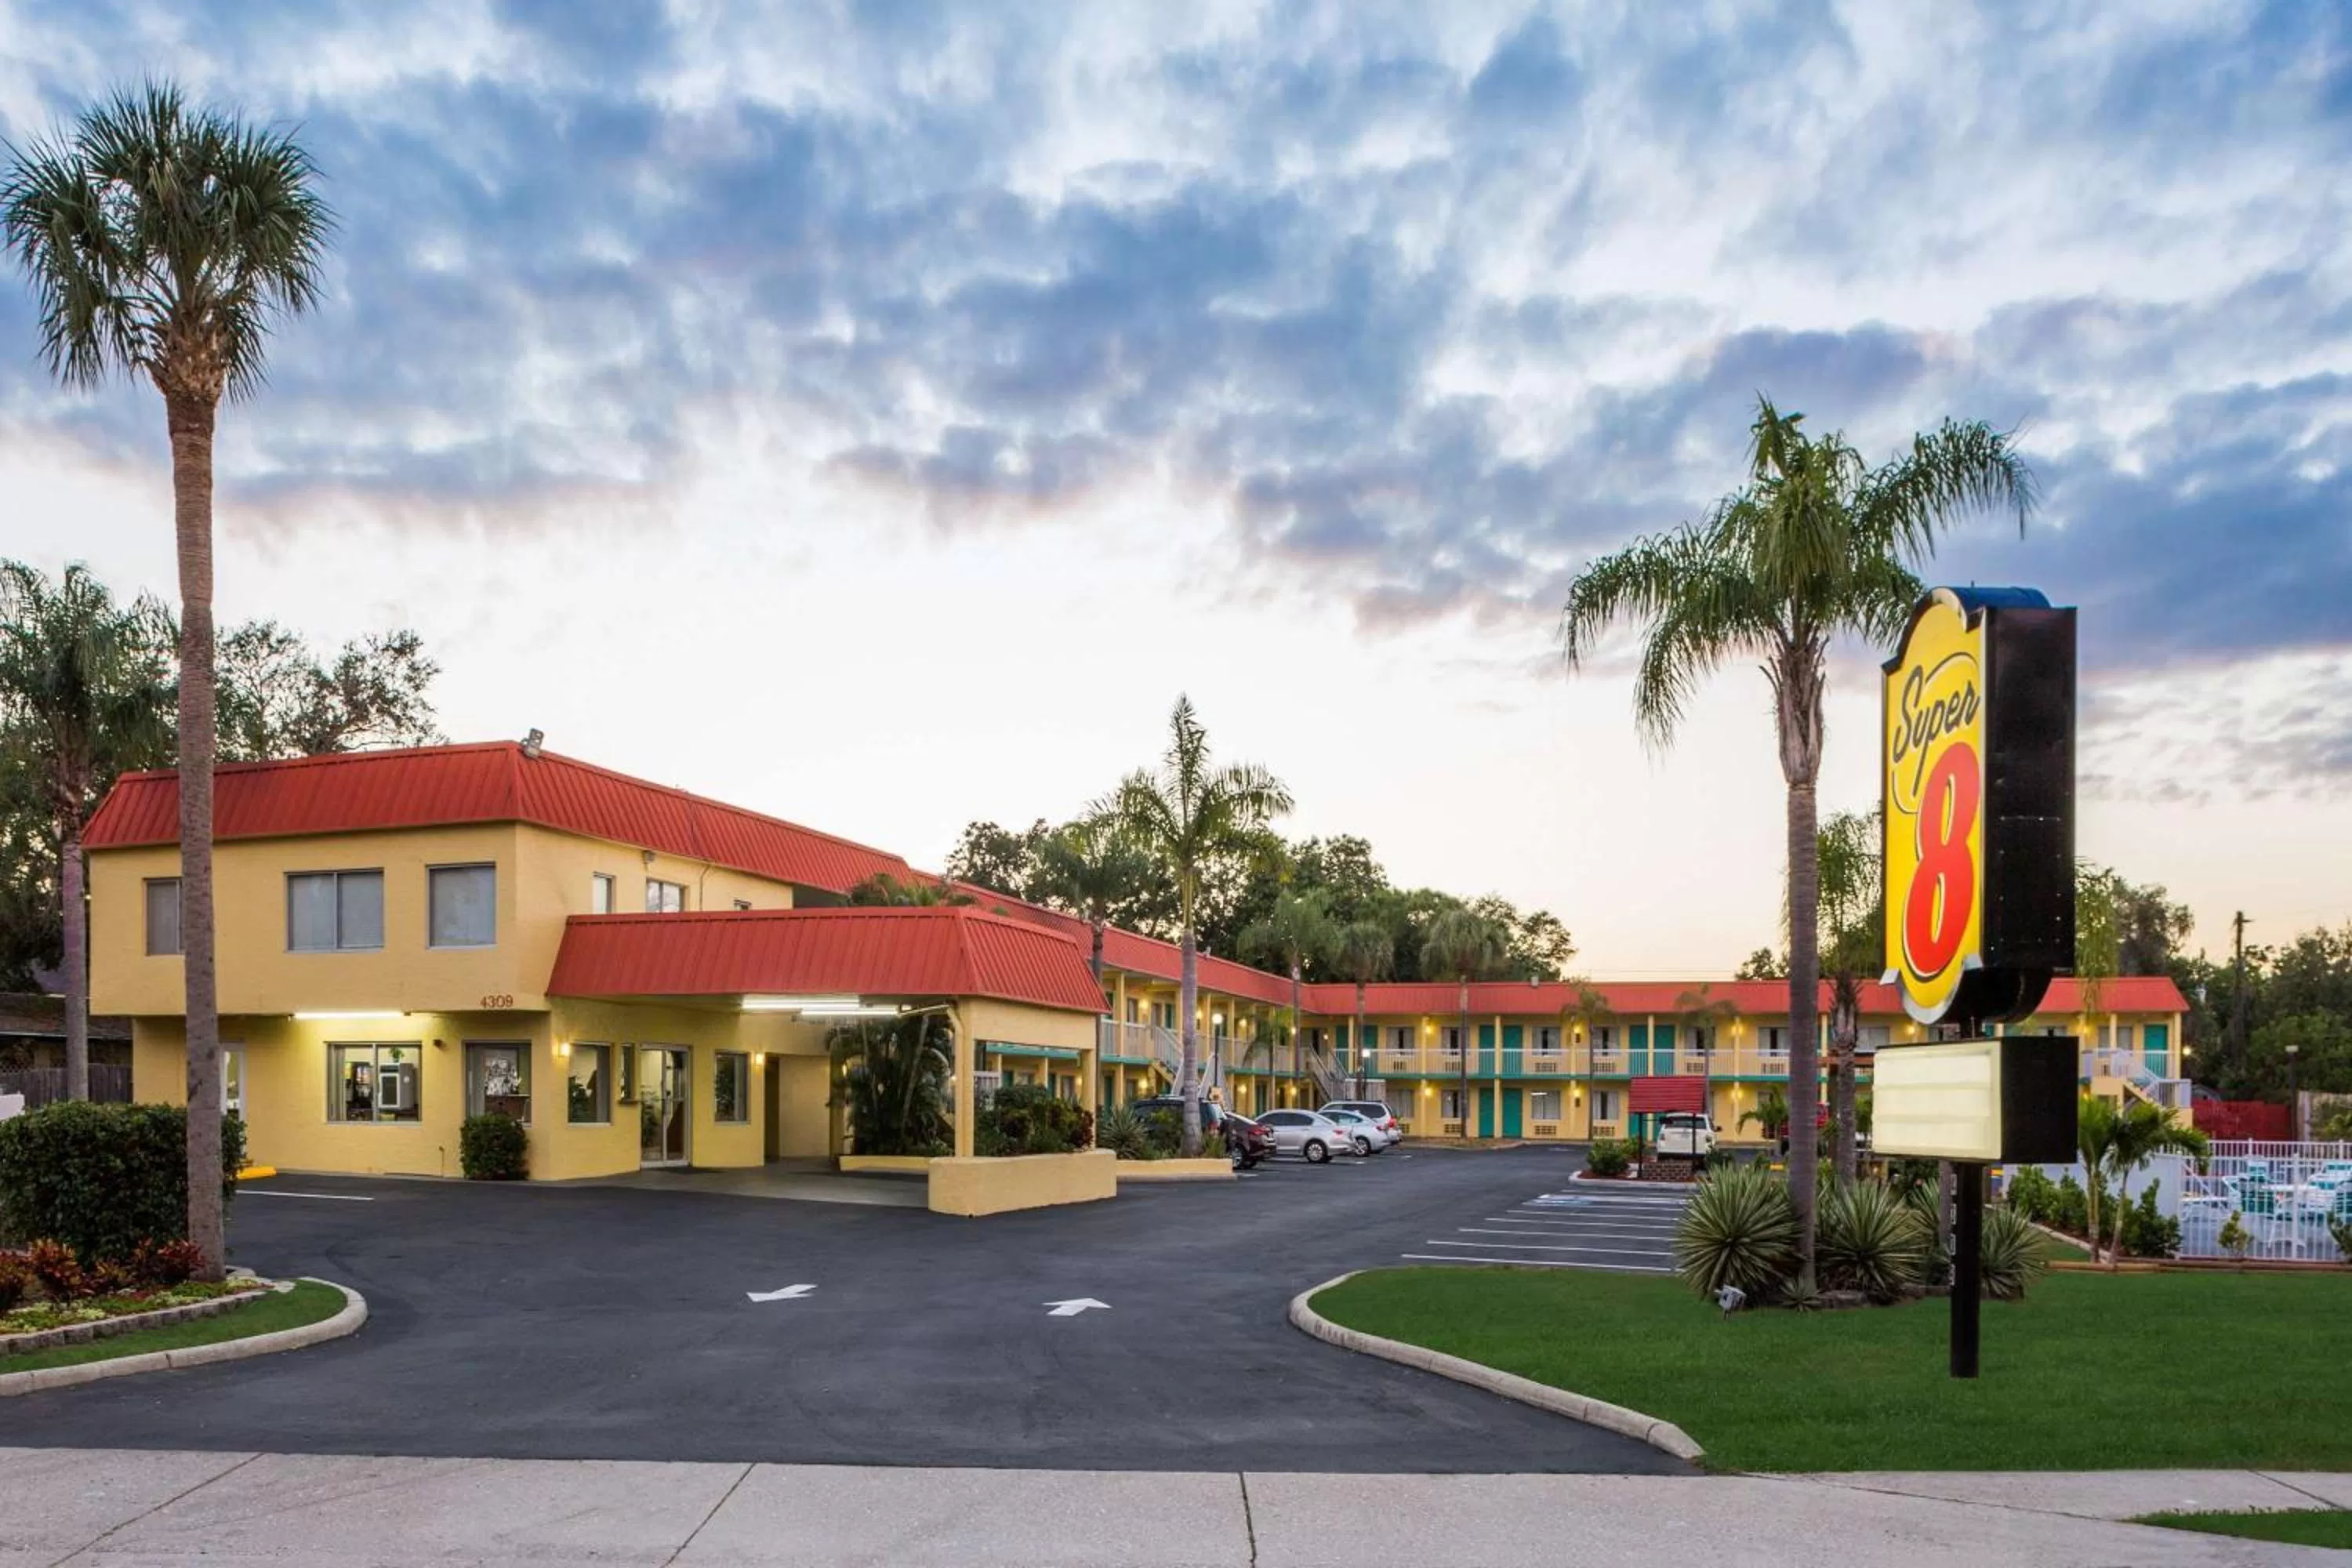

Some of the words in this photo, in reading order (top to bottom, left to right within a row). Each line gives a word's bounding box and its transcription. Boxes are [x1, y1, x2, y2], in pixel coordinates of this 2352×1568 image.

[1893, 665, 1980, 797] Super
[1904, 742, 1980, 978] 8
[480, 994, 514, 1007] 4309
